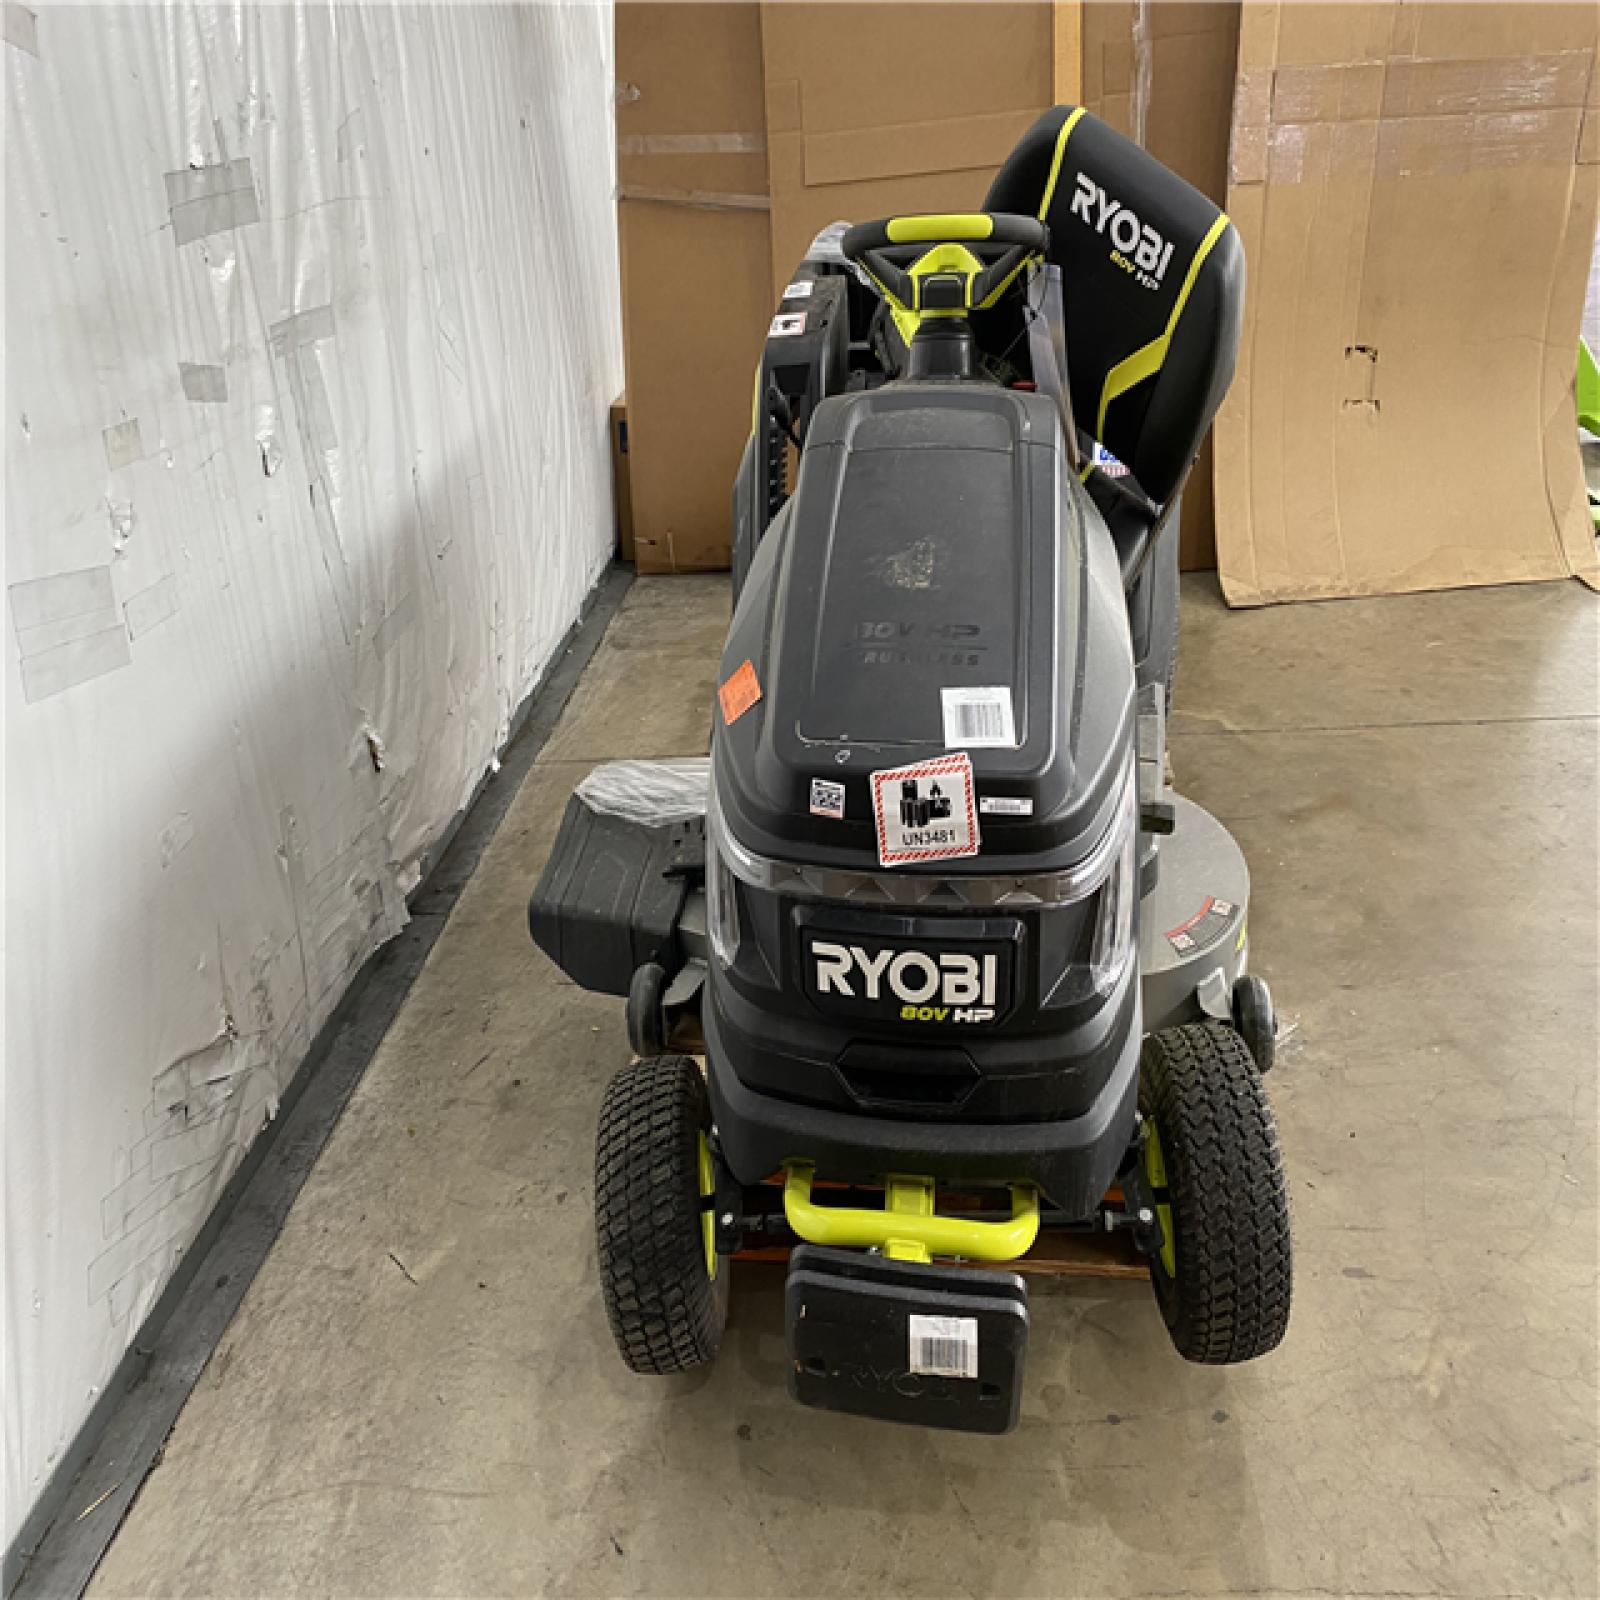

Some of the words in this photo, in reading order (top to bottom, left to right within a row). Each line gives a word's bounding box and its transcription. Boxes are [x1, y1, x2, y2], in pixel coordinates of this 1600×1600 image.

[1070, 172, 1175, 281] RYOBI
[902, 829, 956, 846] UN3481
[811, 940, 998, 1006] RYOBI
[900, 1004, 950, 1021] 80V
[952, 1007, 997, 1023] HP
